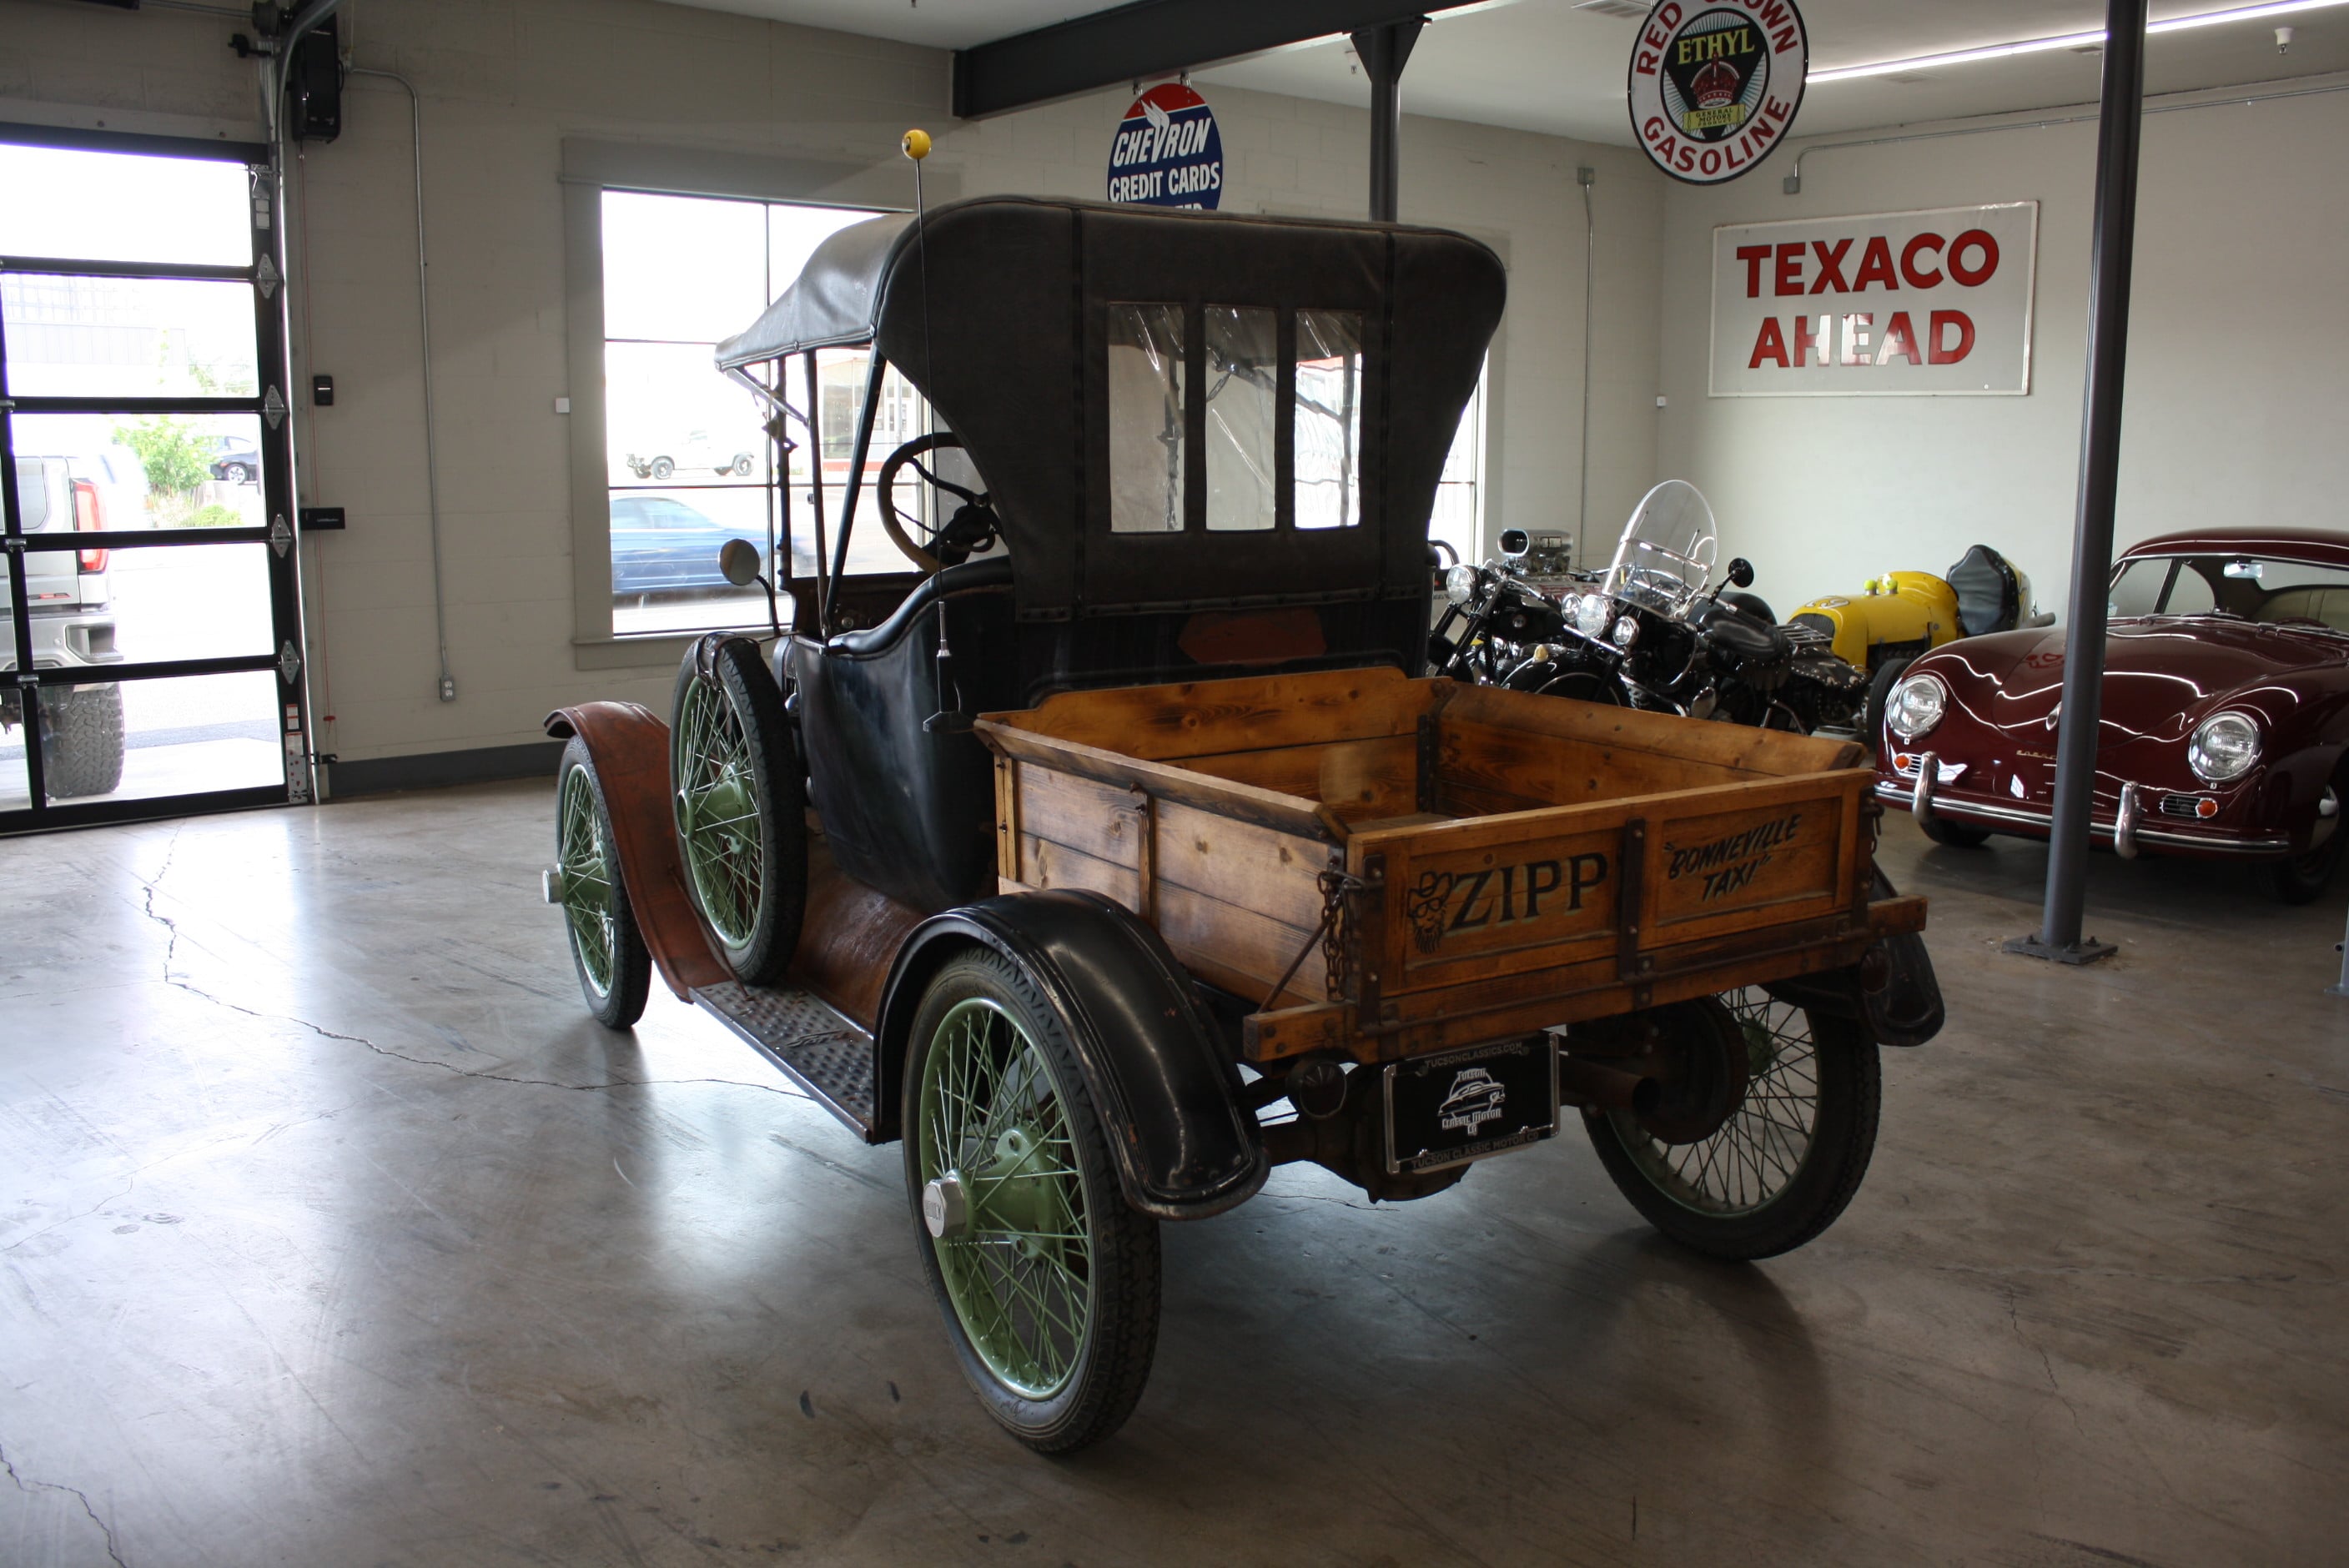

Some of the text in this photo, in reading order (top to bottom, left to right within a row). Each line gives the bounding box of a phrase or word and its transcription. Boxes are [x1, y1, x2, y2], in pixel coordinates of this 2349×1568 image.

[1636, 3, 1683, 75] RED
[1677, 28, 1755, 65] ETHYL
[1113, 114, 1212, 167] CHEVRON
[1643, 96, 1790, 175] GASOLINE
[1109, 162, 1220, 202] CREDIT CARDS
[1737, 229, 1999, 299] TEXACO
[1748, 309, 1975, 369] AHEAD
[1448, 852, 1608, 932] ZIPP
[1452, 1141, 1491, 1160] CLASSIC
